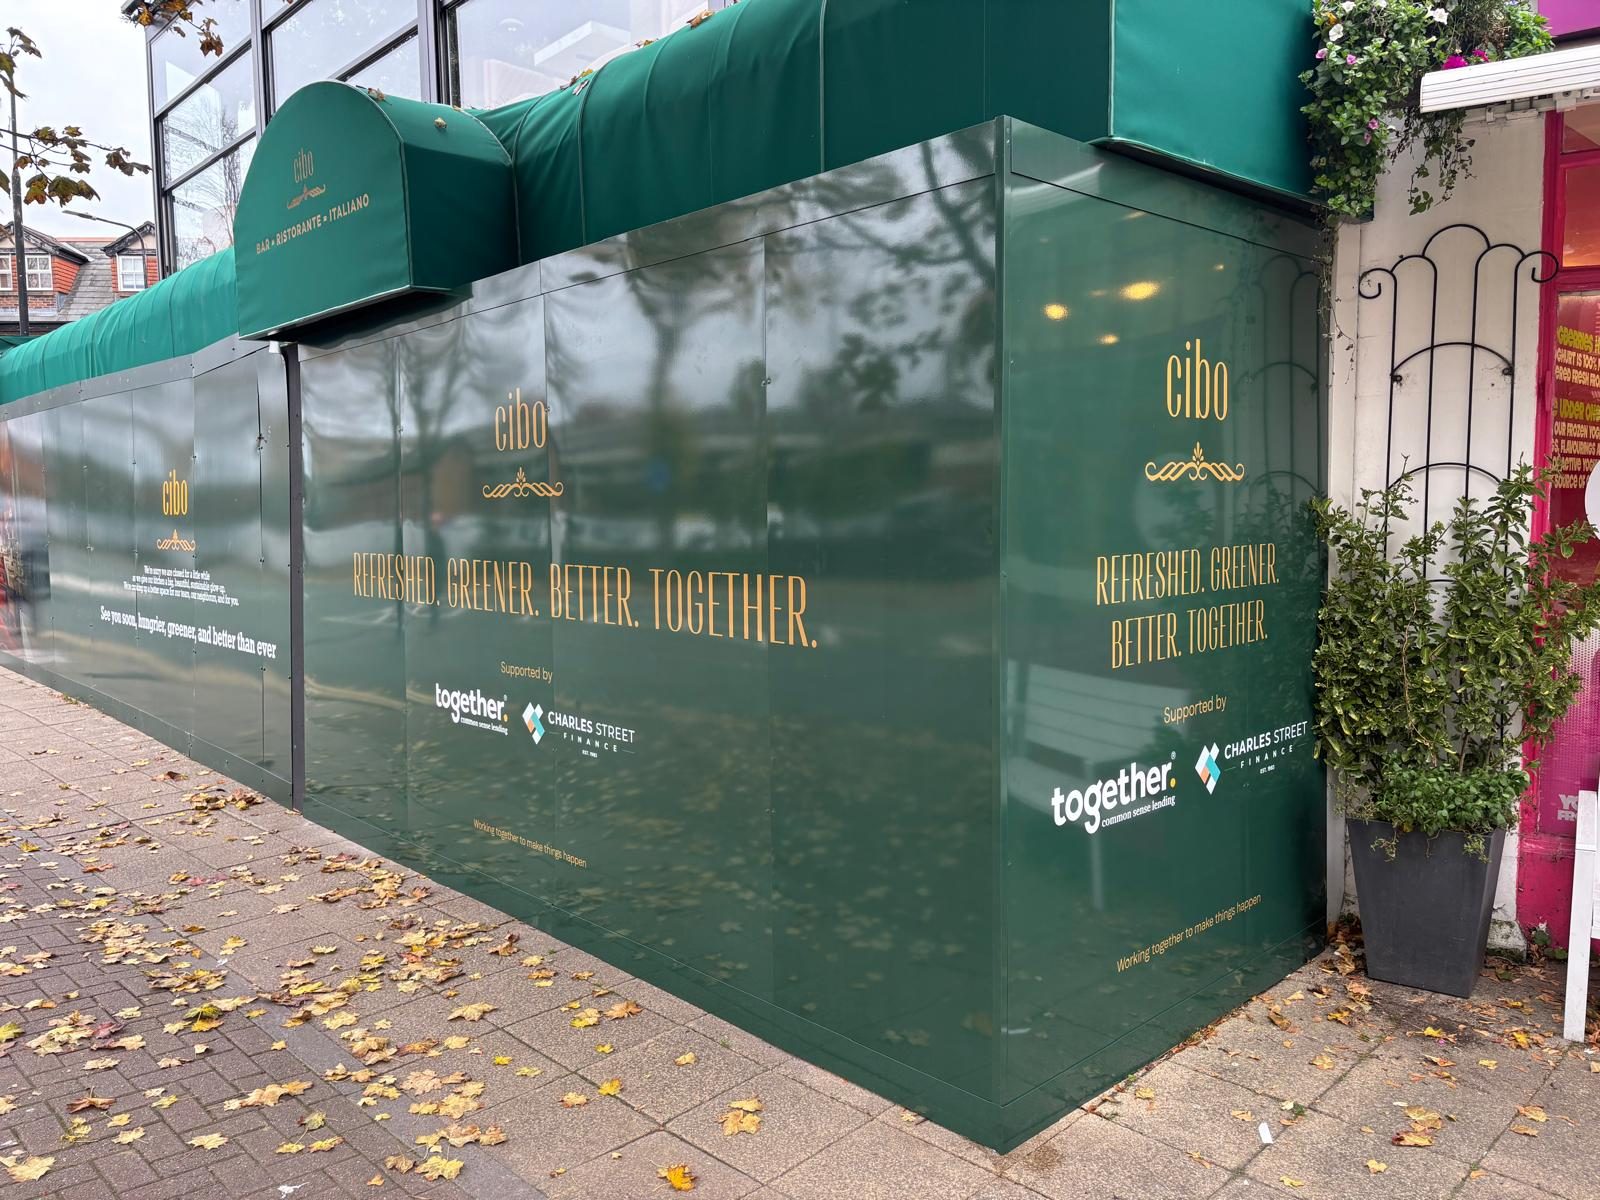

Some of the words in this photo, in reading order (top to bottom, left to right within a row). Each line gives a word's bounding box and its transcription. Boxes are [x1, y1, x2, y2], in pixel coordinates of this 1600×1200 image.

[293, 147, 314, 183] cibo
[256, 238, 271, 254] BAR
[276, 214, 322, 246] RISTORANTE
[329, 193, 369, 222] ITALIANO
[1166, 338, 1228, 421] cibo
[495, 387, 547, 452] cibo
[162, 469, 189, 516] cibo
[1096, 549, 1205, 606] REFRESHED.
[1210, 543, 1279, 592] GREENER.
[353, 552, 440, 606] REFRESHED.
[447, 558, 539, 617] GREENER.
[550, 563, 640, 628] BETTER.
[648, 568, 818, 649] TOGETHER.
[100, 605, 111, 621] See
[111, 610, 121, 625] you
[121, 613, 137, 630] soon,
[138, 612, 166, 637] hungrier,
[167, 622, 197, 644] greener,
[198, 625, 211, 644] and
[212, 626, 236, 649] better
[237, 631, 255, 654] than
[256, 640, 276, 659] ever
[1111, 612, 1182, 670] BETTER.
[1187, 599, 1268, 655] TOGETHER.
[500, 661, 540, 679] Supported
[542, 667, 552, 684] by
[547, 711, 593, 734] CHARLES
[595, 722, 635, 744] STREET
[1163, 698, 1214, 725] Supported
[1215, 694, 1227, 712] by
[563, 732, 617, 752] FINANCE
[1224, 732, 1271, 760] CHARLES
[1273, 720, 1308, 744] STREET
[1240, 744, 1293, 769] FINANCE
[1101, 811, 1132, 828] common
[1132, 804, 1151, 820] sense
[1152, 795, 1176, 812] lending
[473, 818, 495, 836] Working
[495, 828, 519, 841] together
[519, 836, 526, 846] to
[526, 840, 543, 852] make
[543, 844, 562, 860] things
[562, 850, 587, 868] happen
[1116, 947, 1150, 973] Working
[1151, 931, 1185, 955] together
[1185, 927, 1193, 939] to
[1194, 917, 1214, 935] make
[1214, 906, 1236, 924] things
[1236, 894, 1262, 913] happen
